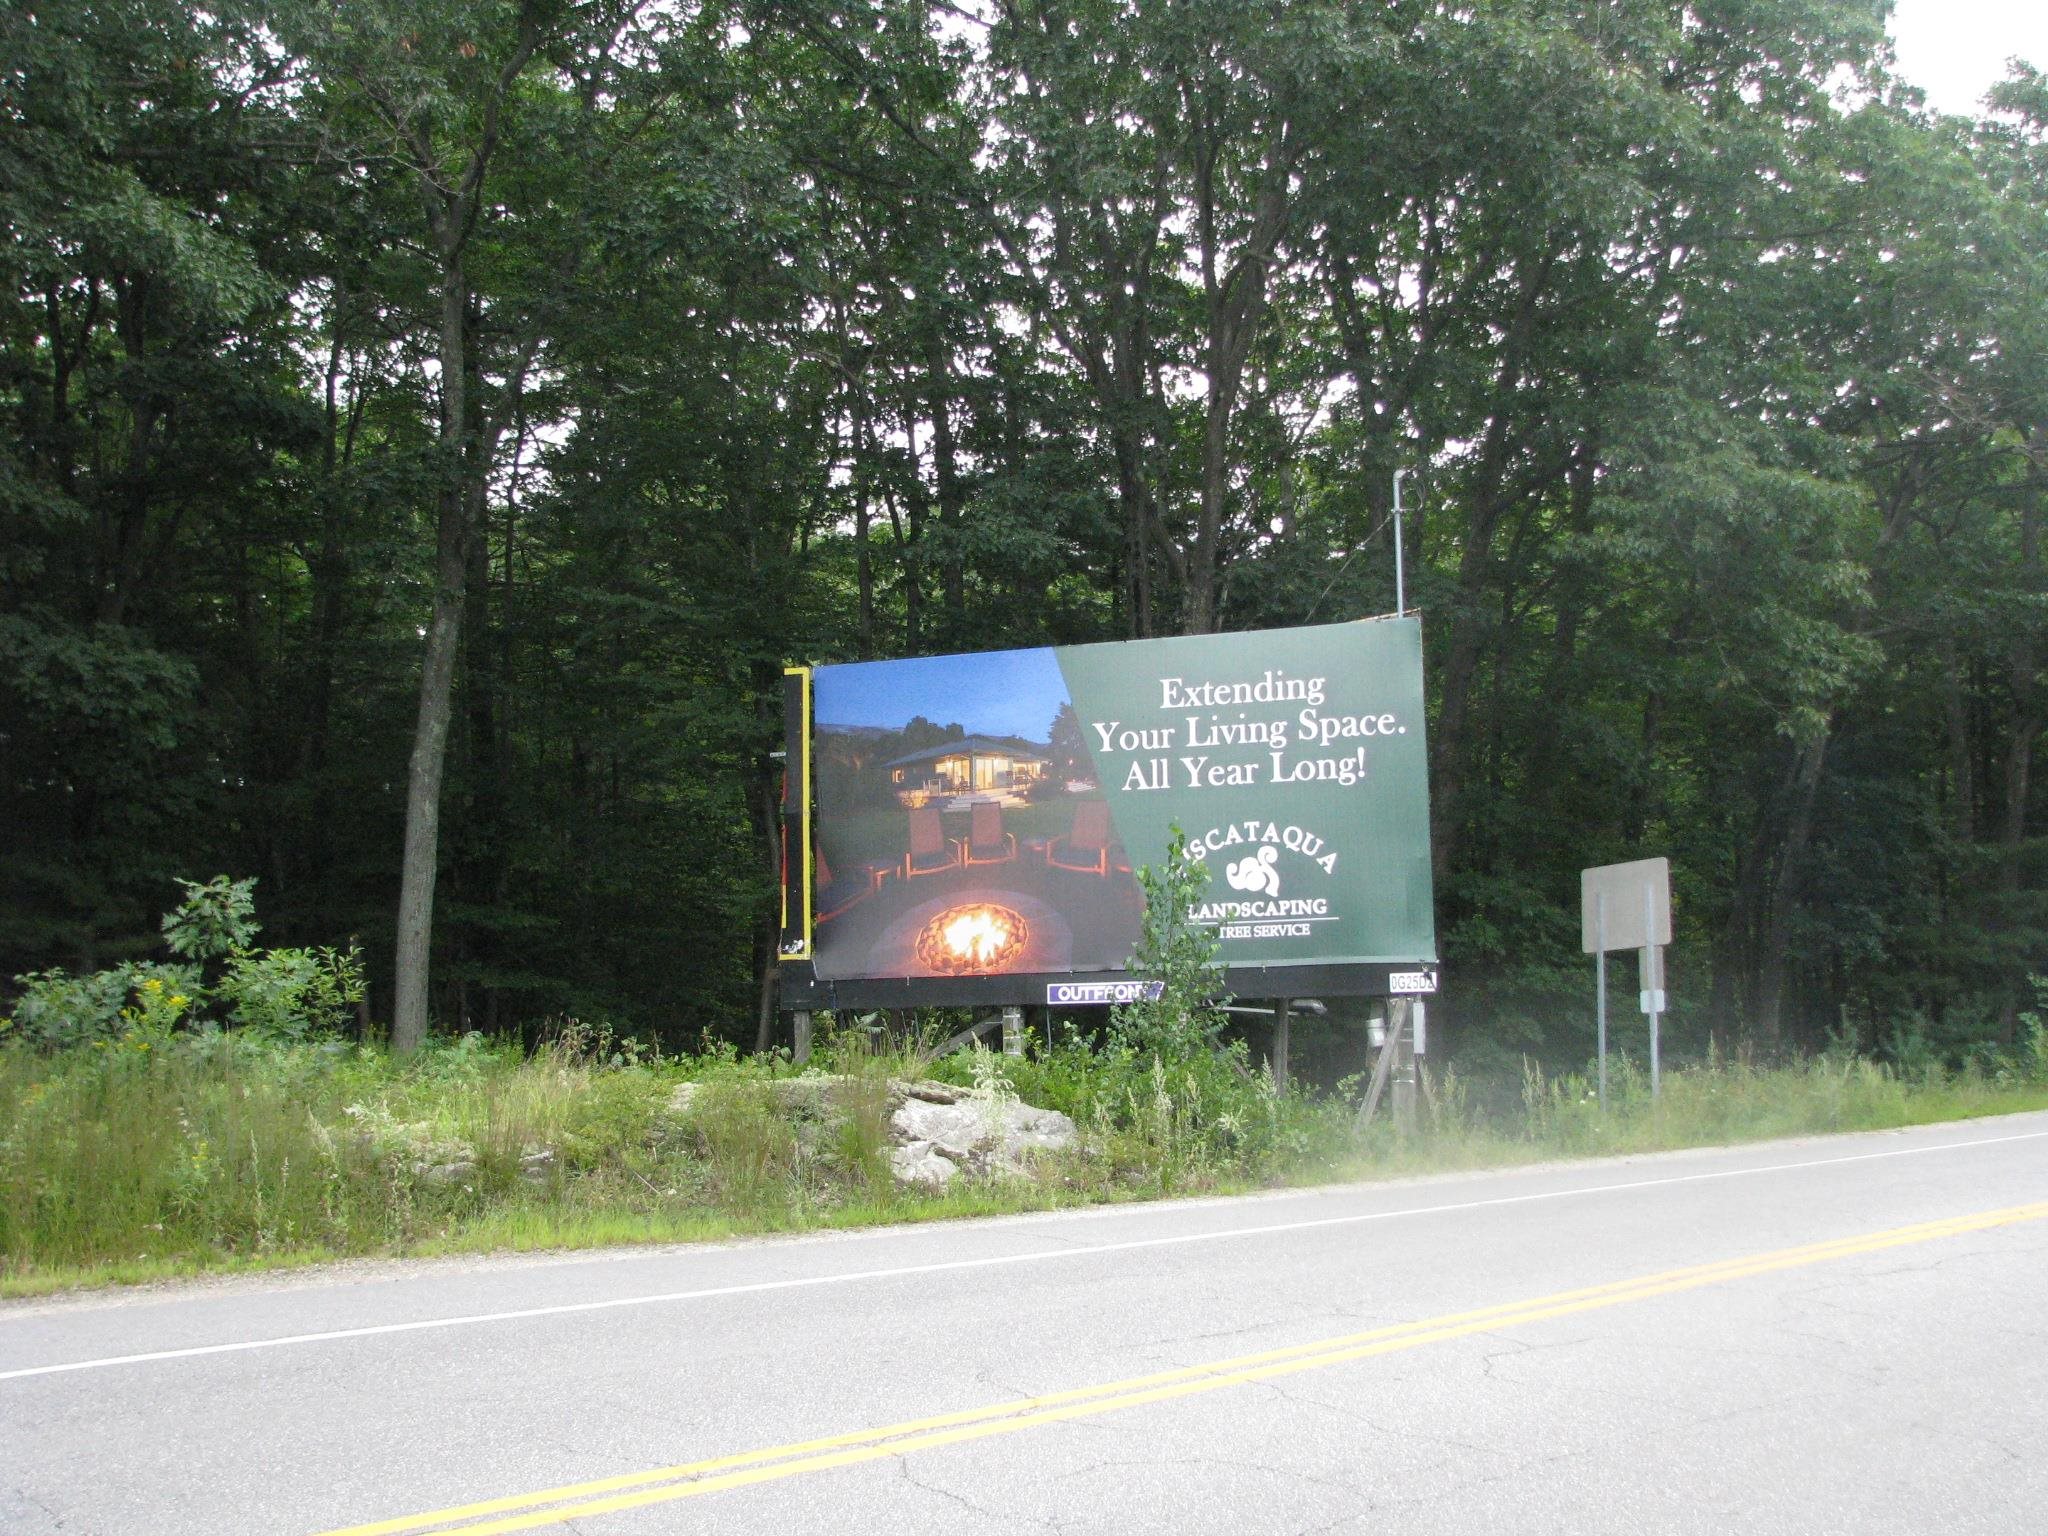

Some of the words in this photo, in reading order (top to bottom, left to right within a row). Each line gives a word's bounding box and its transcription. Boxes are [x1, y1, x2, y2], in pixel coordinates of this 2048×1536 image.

[1160, 670, 1326, 709] Extending
[1092, 721, 1175, 752] Your
[1185, 713, 1288, 748] Living
[1298, 708, 1407, 746] Space.
[1122, 758, 1171, 790] All
[1180, 756, 1259, 787] Year
[1269, 746, 1366, 785] Long!
[1180, 820, 1337, 876] ISCATAQUA
[1188, 898, 1328, 919] LANDSCAPING
[1217, 925, 1252, 939] TREE
[1253, 923, 1311, 937] SERVICE
